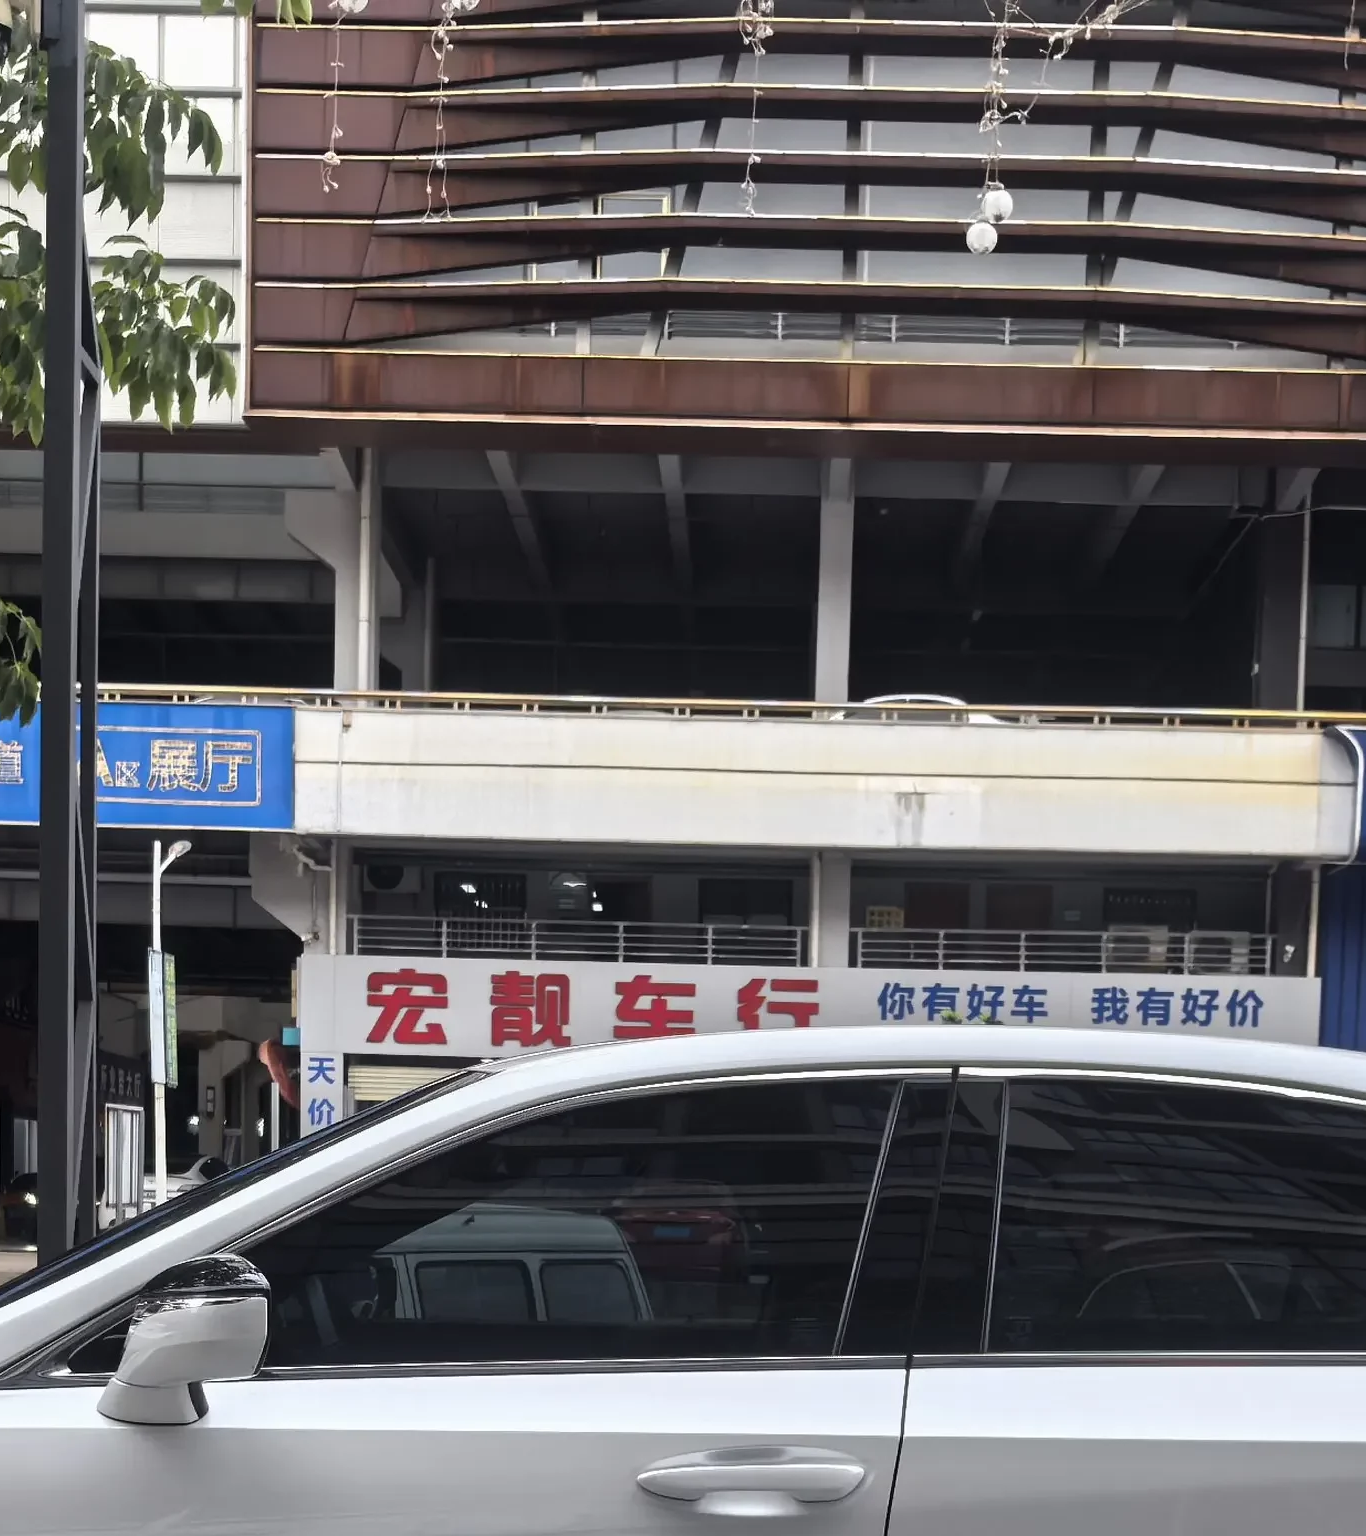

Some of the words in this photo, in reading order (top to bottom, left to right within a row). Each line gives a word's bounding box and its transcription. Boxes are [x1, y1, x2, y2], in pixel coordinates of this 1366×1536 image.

[366, 968, 820, 1047] 宏靓车行
[878, 982, 1049, 1024] 你有好车
[1091, 986, 1264, 1027] 我有好价
